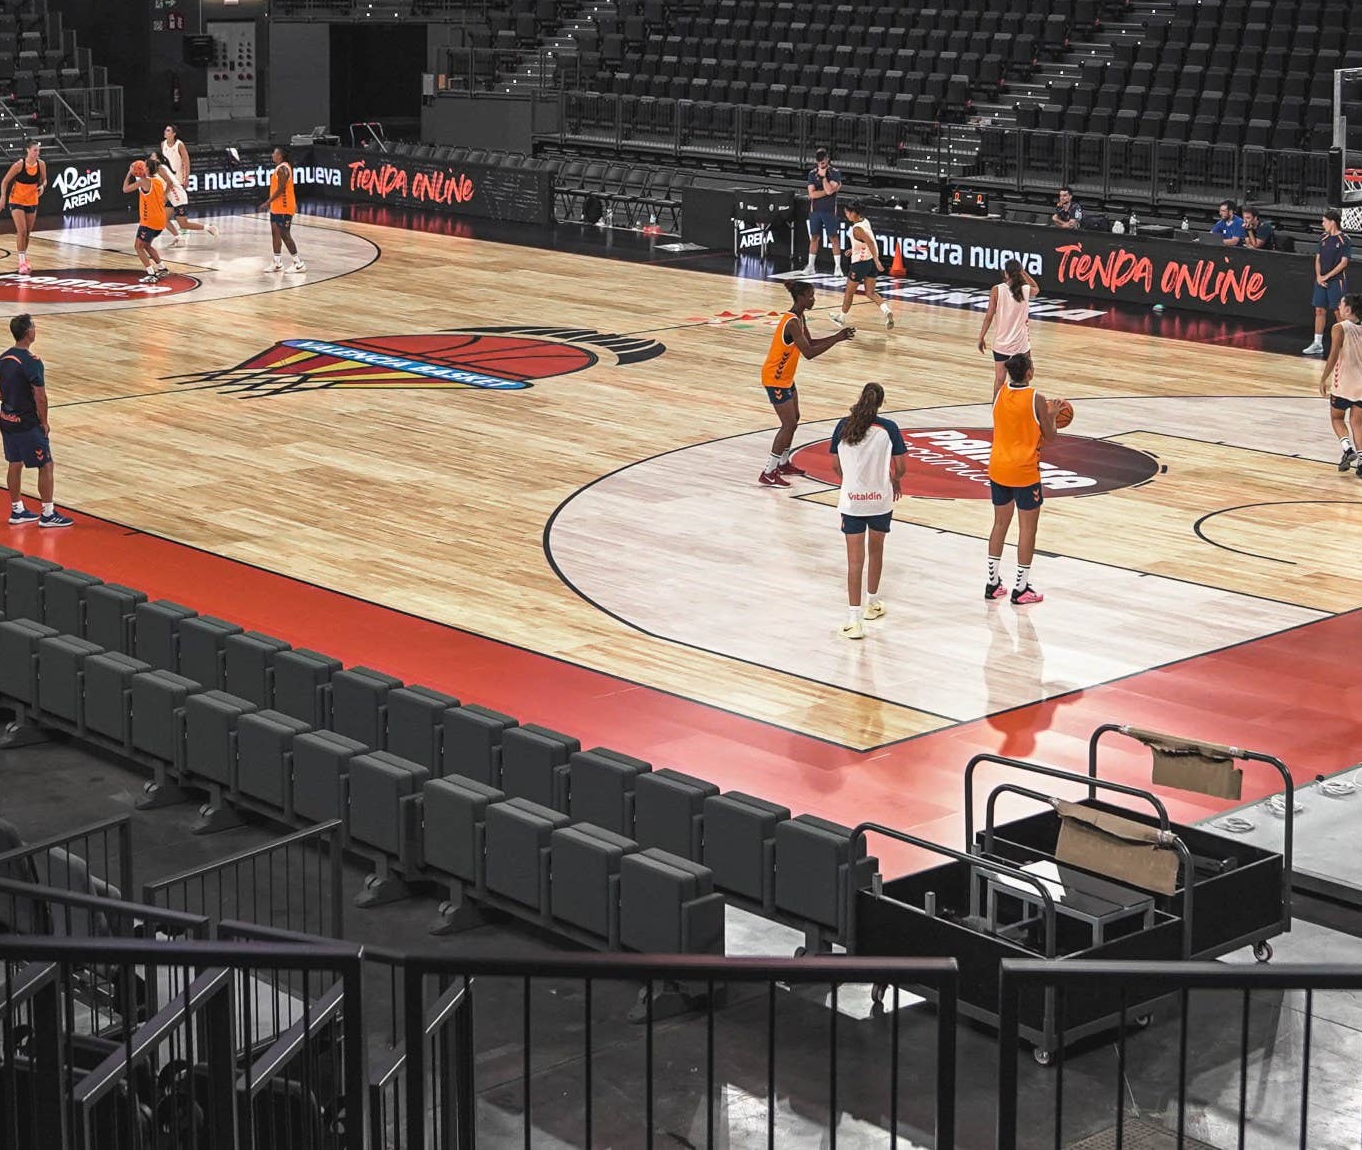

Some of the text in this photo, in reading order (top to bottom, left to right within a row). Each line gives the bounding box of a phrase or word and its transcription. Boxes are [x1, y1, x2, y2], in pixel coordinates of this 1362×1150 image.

[204, 165, 273, 191] nuestr
[293, 165, 342, 187] nueva
[63, 190, 101, 211] ARENA
[876, 234, 963, 266] nuestra
[296, 339, 516, 389] VALENCIA BASKET
[906, 430, 1098, 490] PAMSA
